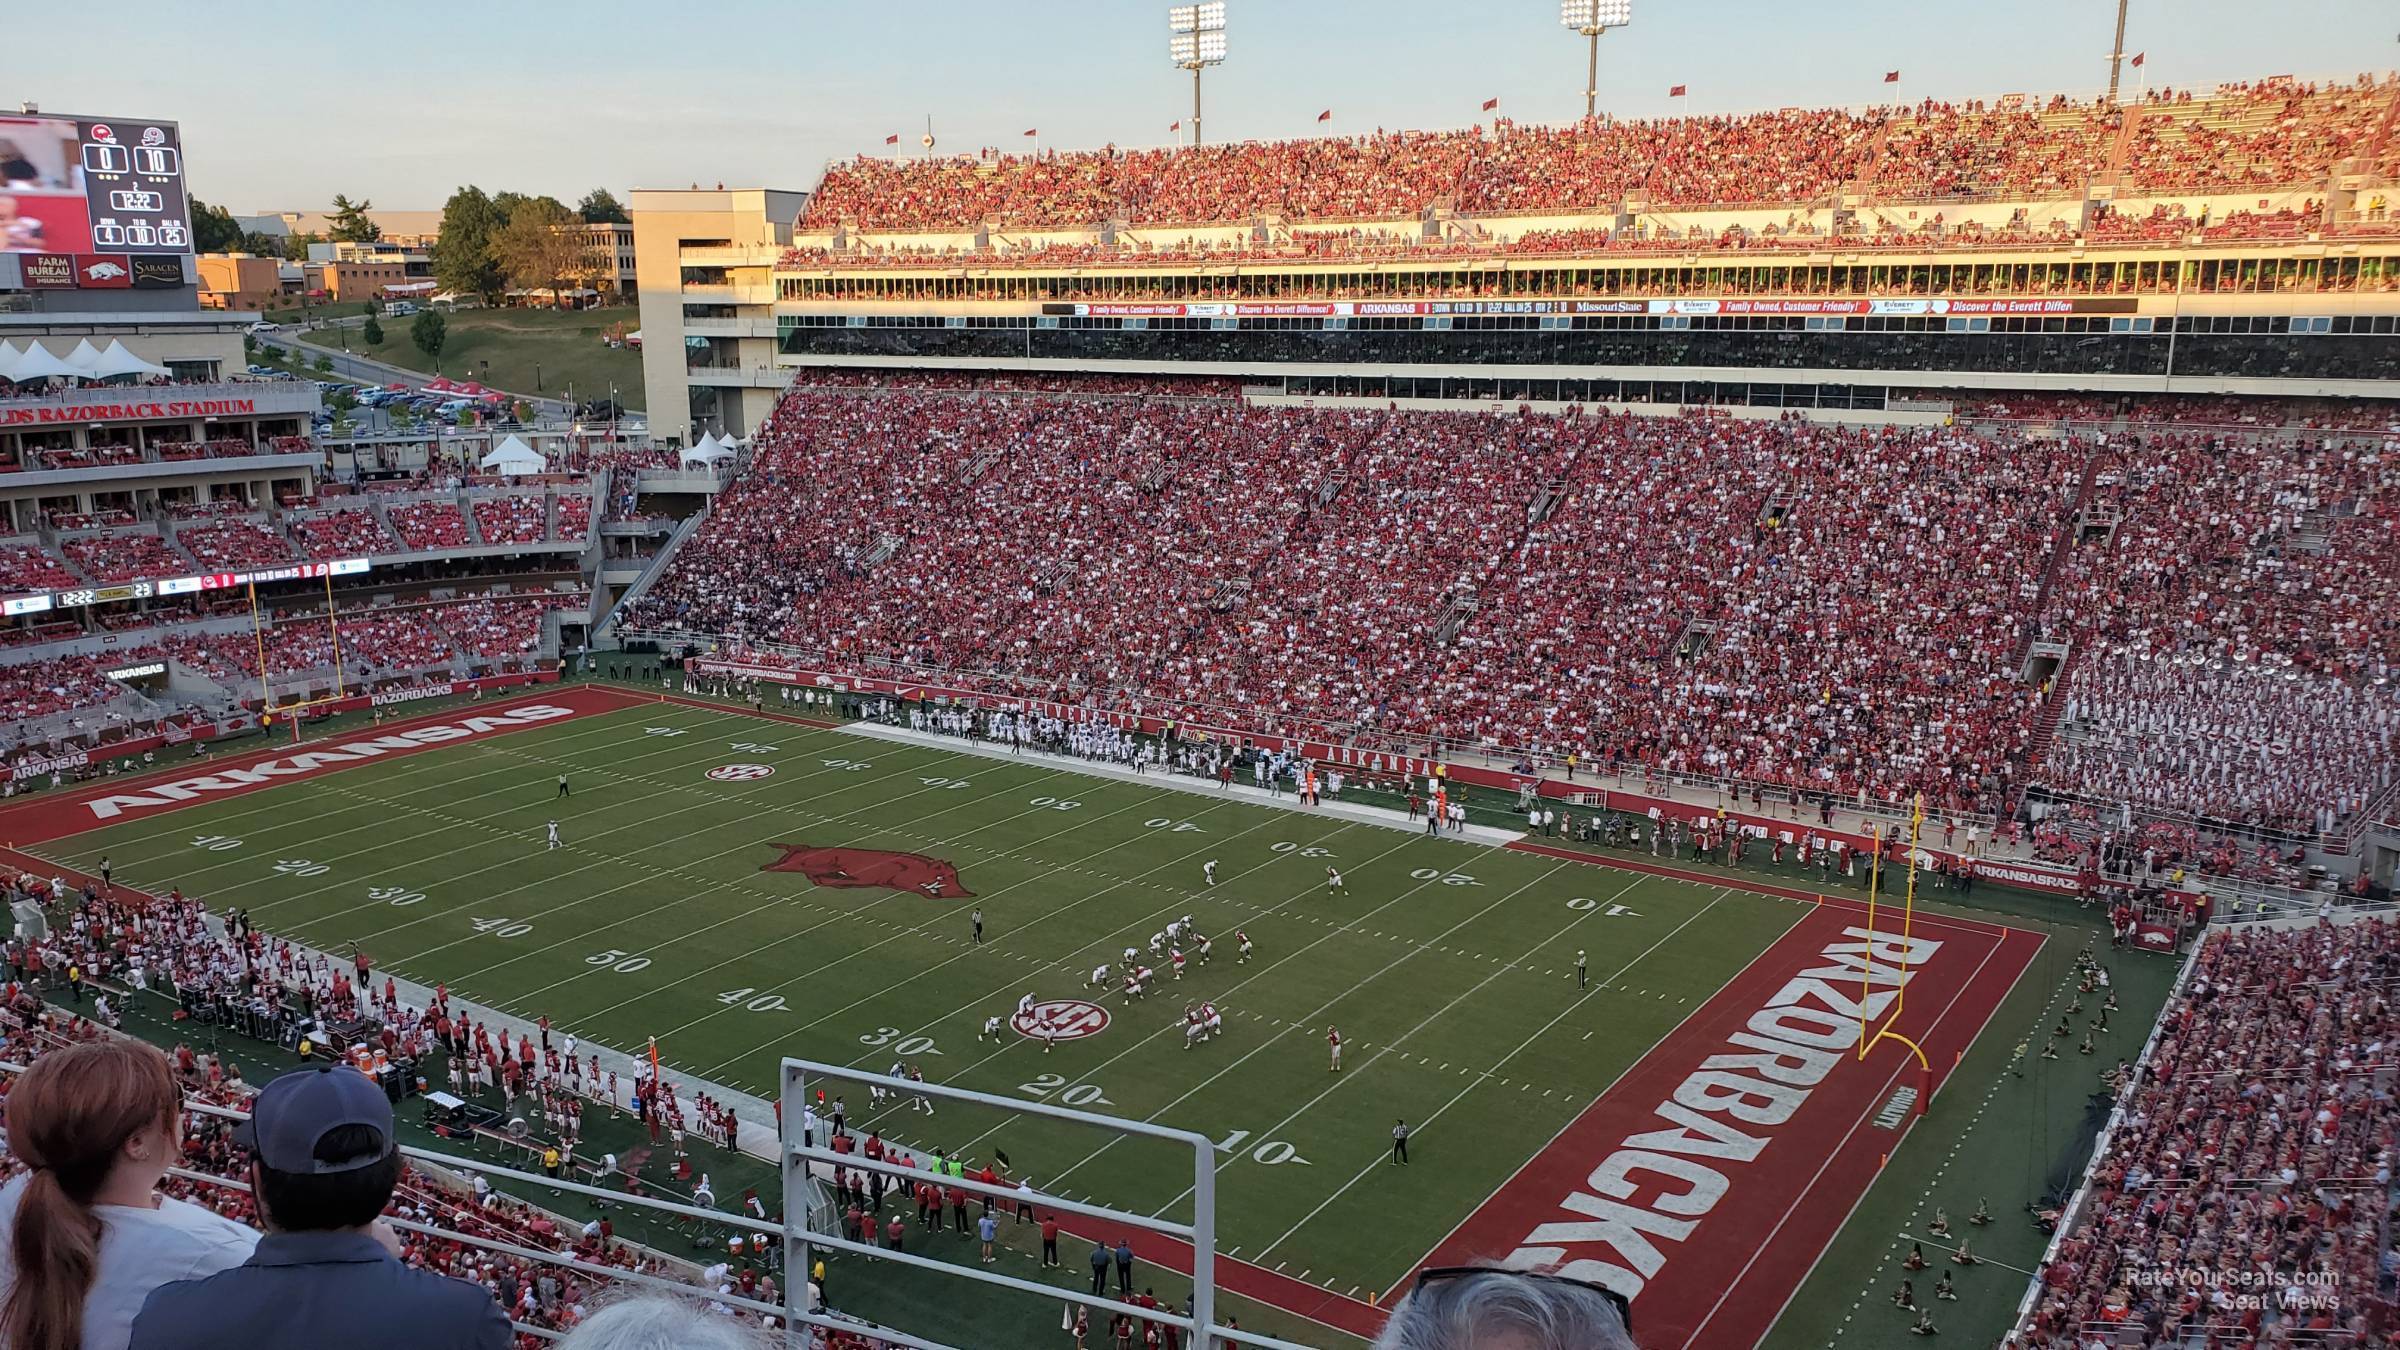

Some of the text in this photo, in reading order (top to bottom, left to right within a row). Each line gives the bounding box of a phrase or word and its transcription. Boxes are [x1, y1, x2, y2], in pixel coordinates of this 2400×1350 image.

[100, 147, 112, 170] 0
[145, 149, 165, 172] 10
[132, 181, 138, 191] 2
[121, 193, 151, 209] 12:22
[105, 227, 114, 242] 4
[135, 228, 148, 243] 10
[165, 229, 180, 244] 25
[38, 257, 68, 266] FARM
[28, 266, 70, 276] BUREAU
[1093, 304, 1110, 315] Family
[1130, 304, 1154, 314] Customer
[1238, 304, 1262, 314] Discover
[1263, 304, 1274, 314] the
[1275, 304, 1296, 314] Everett
[1360, 304, 1415, 314] ARKANSAS
[1435, 303, 1450, 313] DOWN
[1524, 302, 1532, 312] 25
[1576, 302, 1642, 312] Missouri State
[1726, 301, 1859, 313] Family Owned, Customer Friendly!
[1952, 301, 1989, 312] Discover
[1992, 301, 2006, 312] the
[2009, 301, 2041, 312] Everett
[38, 402, 164, 422] RAZORBACK
[168, 399, 256, 417] STADIUM
[303, 565, 312, 578] 10
[62, 590, 94, 605] 12:22
[134, 583, 150, 597] 23
[107, 663, 164, 681] ARKANSAS
[371, 685, 453, 707] RAZORBACKS
[12, 752, 88, 781] ARKANSAS
[88, 705, 575, 819] ARKANSAS
[922, 776, 971, 789] 40
[1030, 796, 1082, 811] 50
[1144, 818, 1199, 833] 40
[190, 835, 244, 850] 10
[1269, 841, 1328, 858] 30
[273, 859, 331, 877] 20
[1409, 868, 1475, 886] 20
[368, 886, 426, 906] 30
[1566, 898, 1632, 917] 10
[472, 917, 534, 938] 40
[585, 949, 652, 973] 50
[717, 987, 786, 1012] 40
[859, 1026, 934, 1055] 30
[1018, 1073, 1103, 1105] 20
[1214, 1129, 1296, 1165] 10
